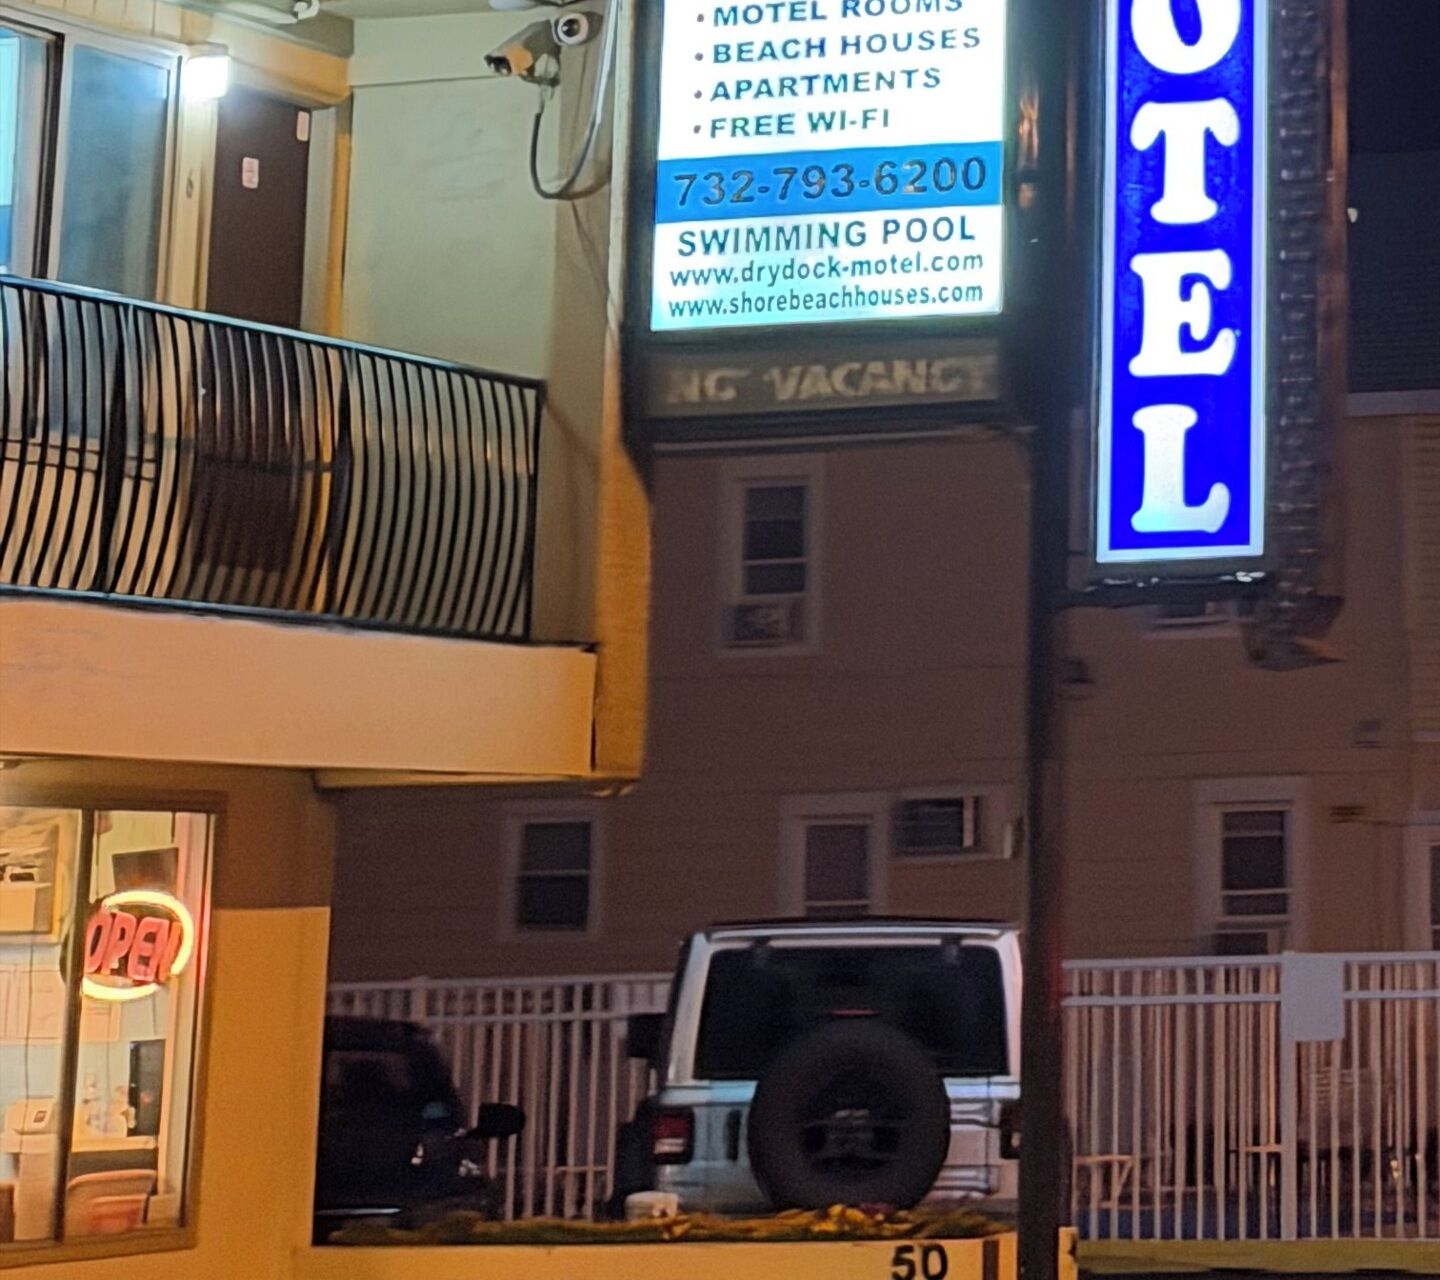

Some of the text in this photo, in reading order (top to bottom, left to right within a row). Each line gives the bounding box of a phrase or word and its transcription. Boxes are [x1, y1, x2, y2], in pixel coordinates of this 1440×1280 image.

[713, 0, 828, 28] MOTEL
[713, 27, 981, 64] BEACH HOUSES
[710, 67, 942, 102] APARTMENTS
[710, 108, 890, 139] FREE WI-FI
[674, 156, 987, 206] 732-793-6200
[677, 215, 976, 257] SWIMMING POOL
[670, 251, 984, 288] www.drydock-motel.com
[668, 284, 984, 318] www.shorebeachhouses.com
[84, 905, 182, 981] OPEN
[891, 1243, 948, 1280] 50
